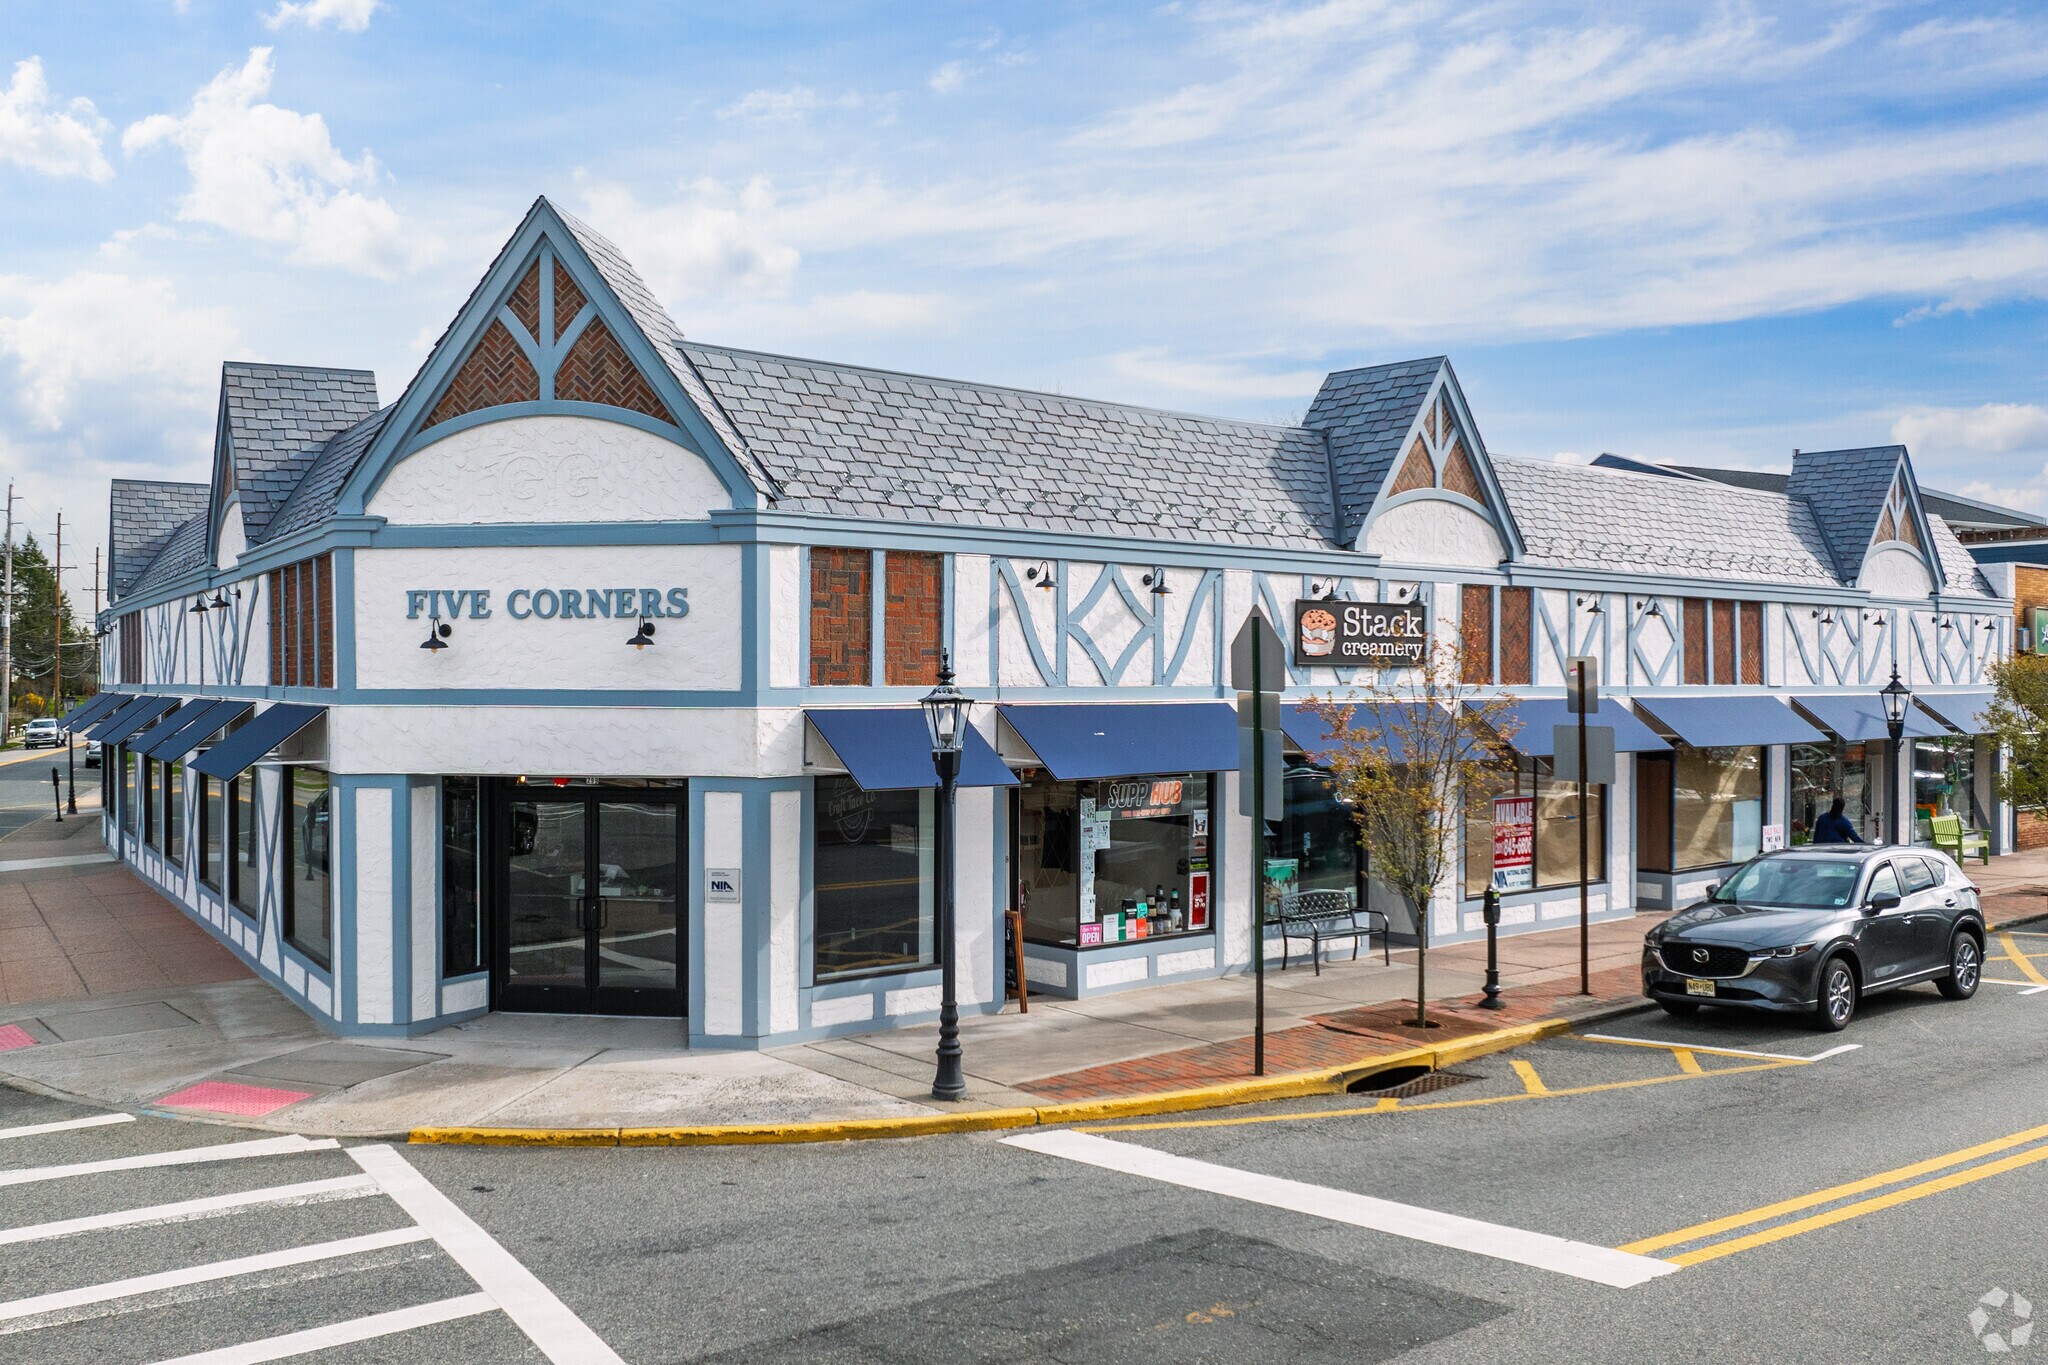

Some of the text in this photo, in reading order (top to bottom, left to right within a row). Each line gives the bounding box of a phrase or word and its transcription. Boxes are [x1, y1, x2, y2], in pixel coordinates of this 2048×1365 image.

[406, 587, 690, 620] FIVE CORNERS
[1343, 606, 1423, 638] Stack
[1342, 641, 1423, 661] creamery
[847, 794, 864, 810] Taco
[1108, 780, 1183, 809] SUPP HUB
[1495, 802, 1533, 825] AVAILABLE
[711, 881, 734, 890] NIA
[1081, 932, 1100, 943] OPEN
